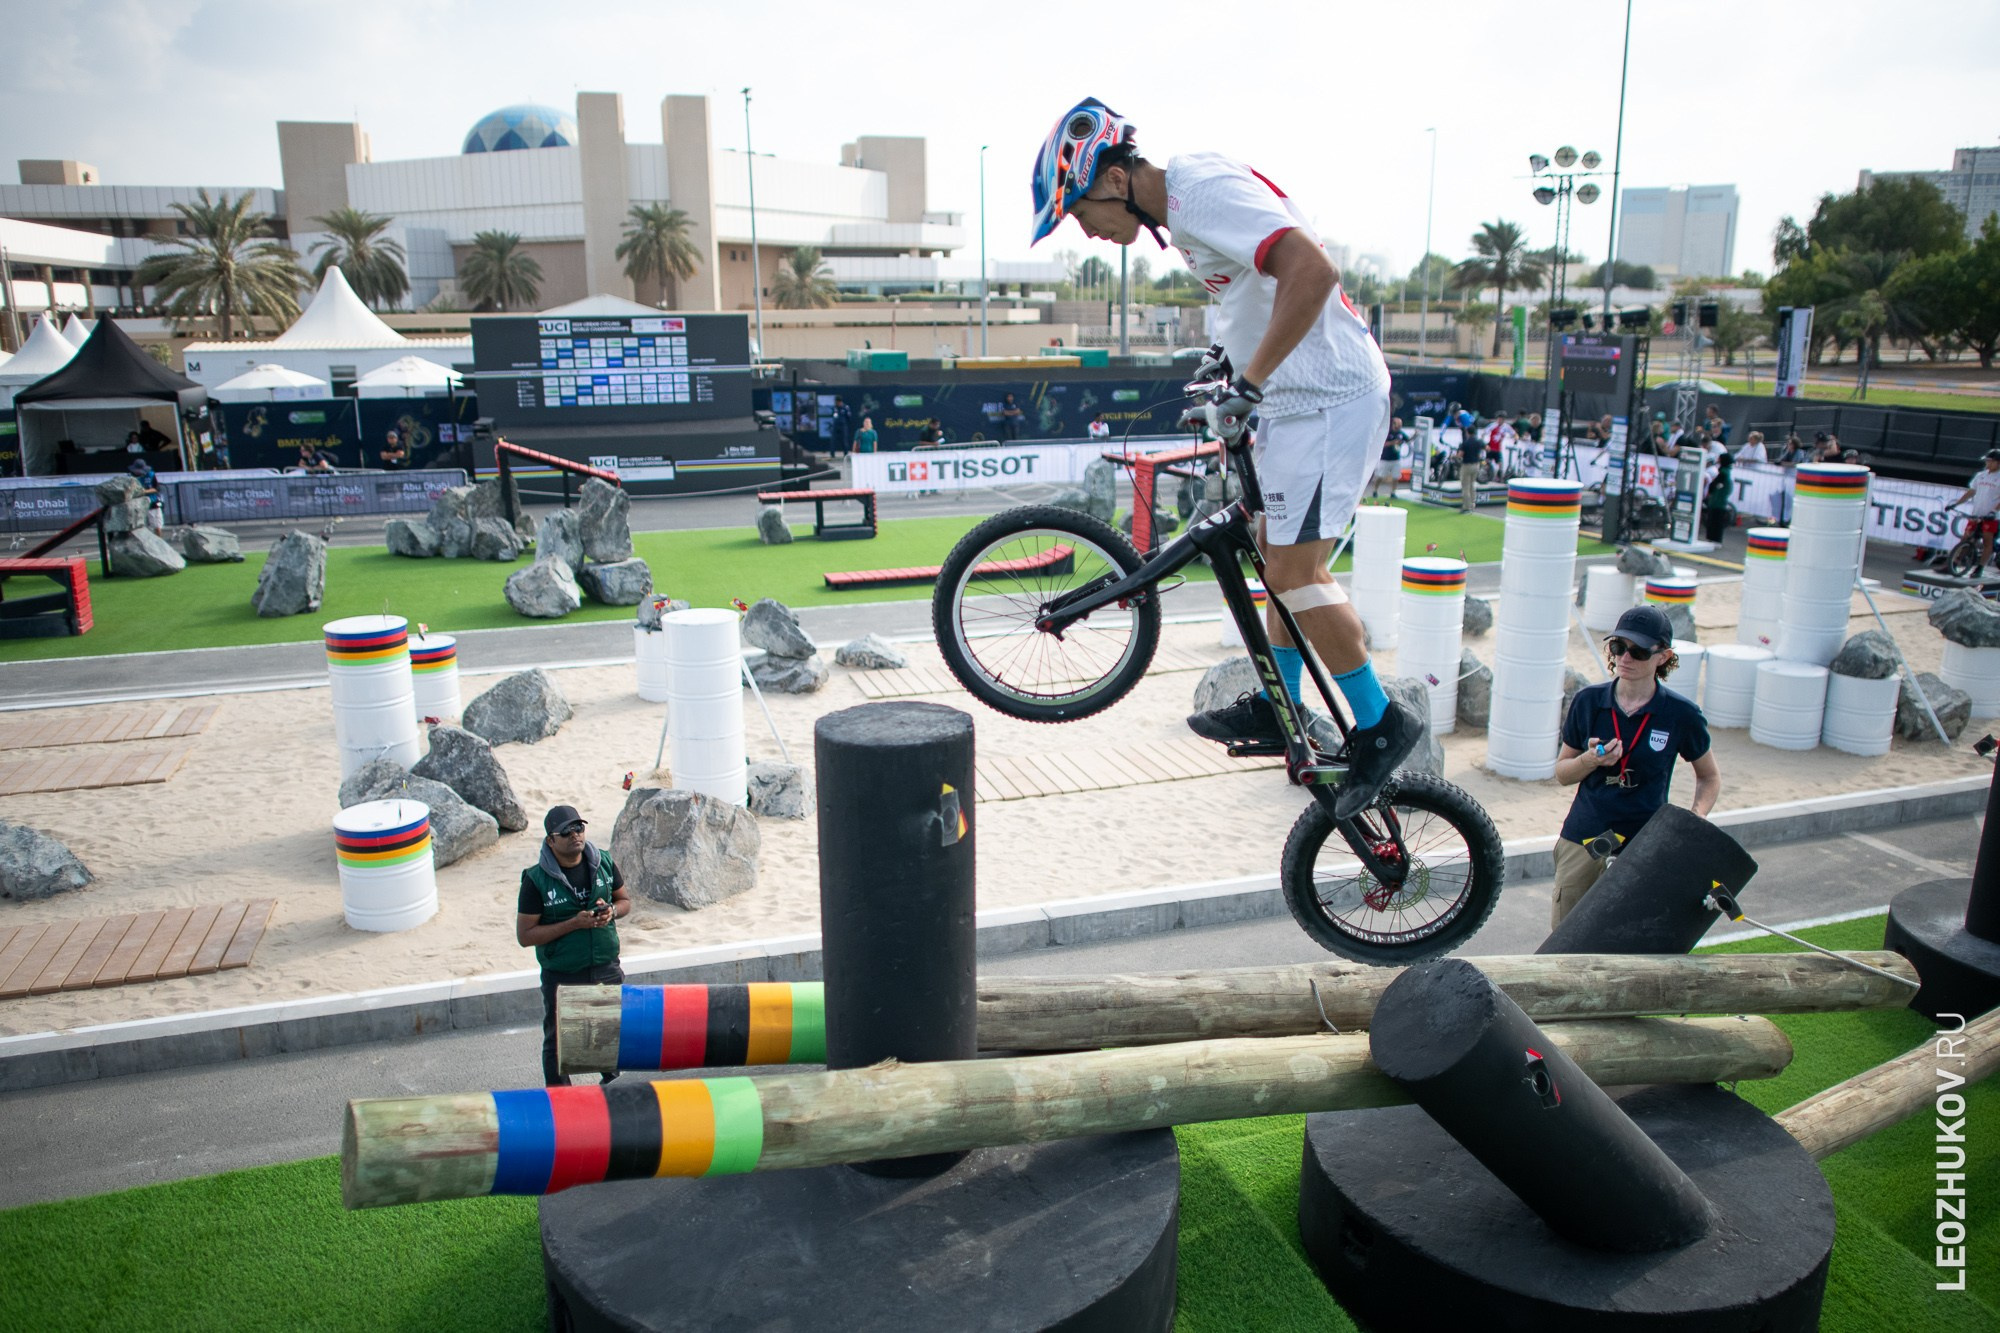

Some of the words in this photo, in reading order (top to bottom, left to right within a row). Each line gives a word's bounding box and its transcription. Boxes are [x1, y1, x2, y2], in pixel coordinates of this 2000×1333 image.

[1105, 122, 1115, 140] urge
[544, 322, 567, 333] UCI
[594, 458, 615, 467] UCI
[932, 455, 1039, 480] TISSOT
[314, 487, 334, 495] Abu
[336, 485, 363, 494] Dhabi
[403, 483, 421, 491] Abu
[223, 491, 242, 499] Abu
[245, 489, 274, 498] Dhabi
[14, 500, 34, 509] Abu
[37, 499, 68, 509] Dhabi
[15, 510, 39, 518] Sports
[41, 508, 69, 516] Council
[1871, 502, 1969, 539] TISSO
